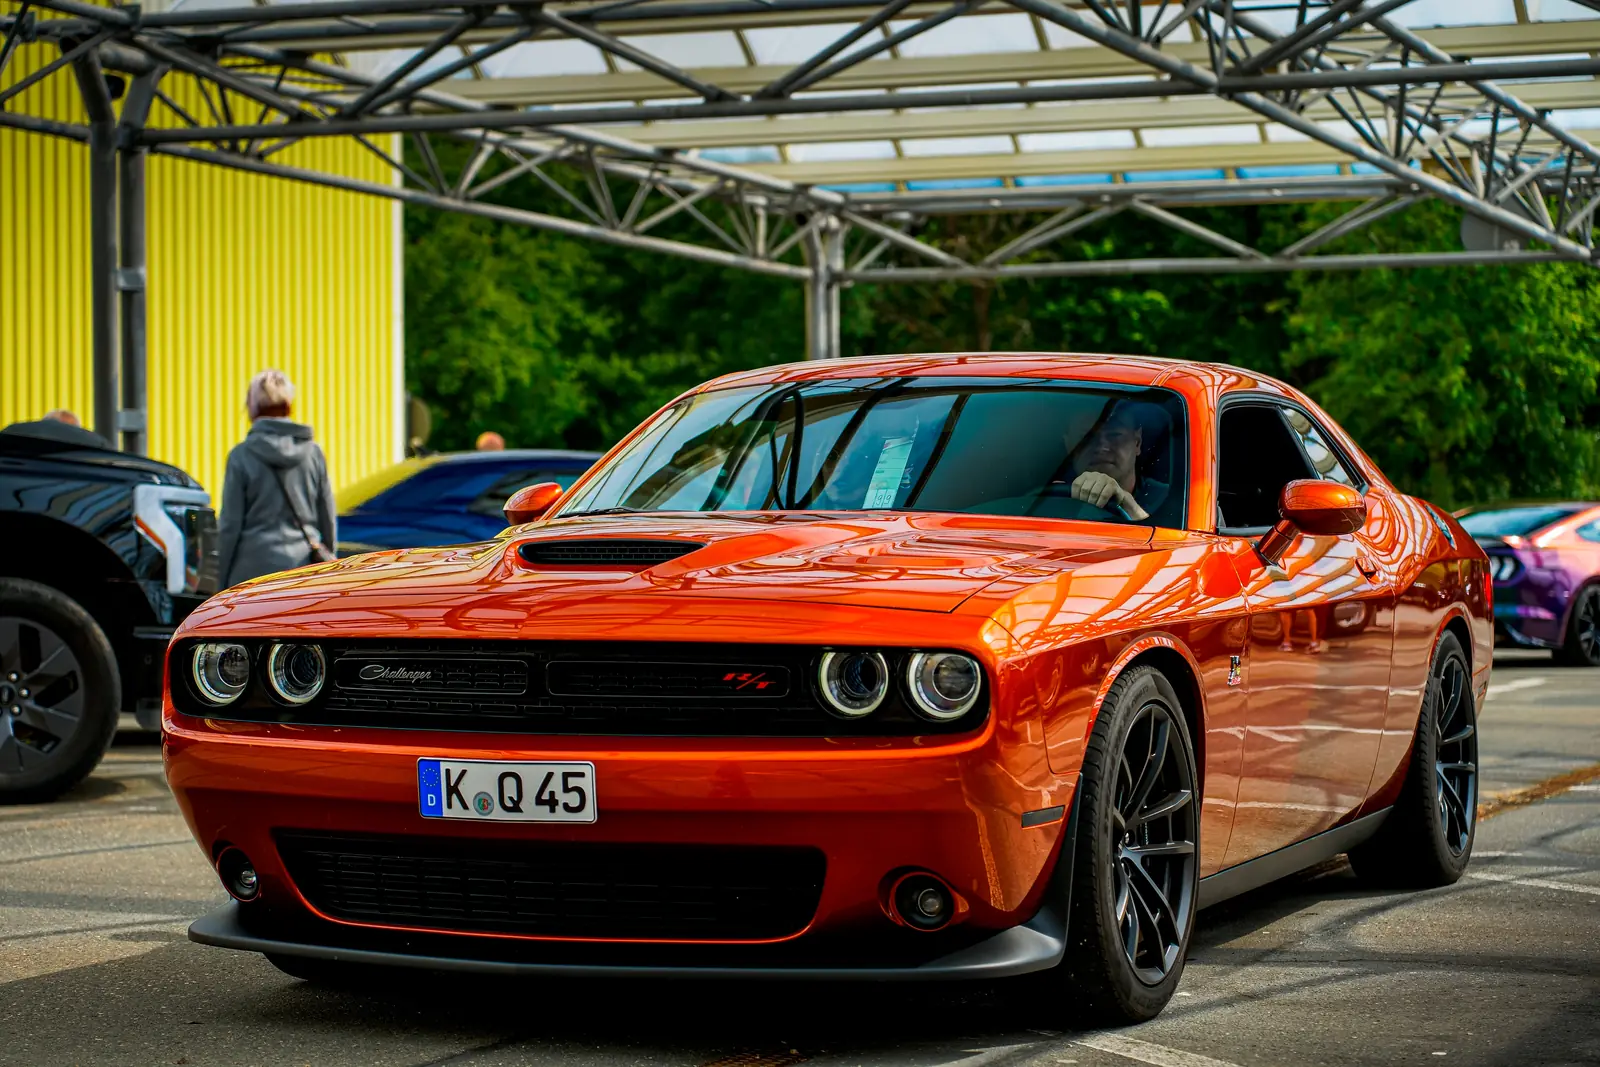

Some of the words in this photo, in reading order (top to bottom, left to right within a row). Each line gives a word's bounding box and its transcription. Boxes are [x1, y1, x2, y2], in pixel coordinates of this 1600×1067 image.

[359, 664, 432, 683] Challenger
[427, 794, 436, 807] D
[445, 768, 469, 811] K
[498, 771, 524, 813] Q
[535, 771, 587, 814] 45
